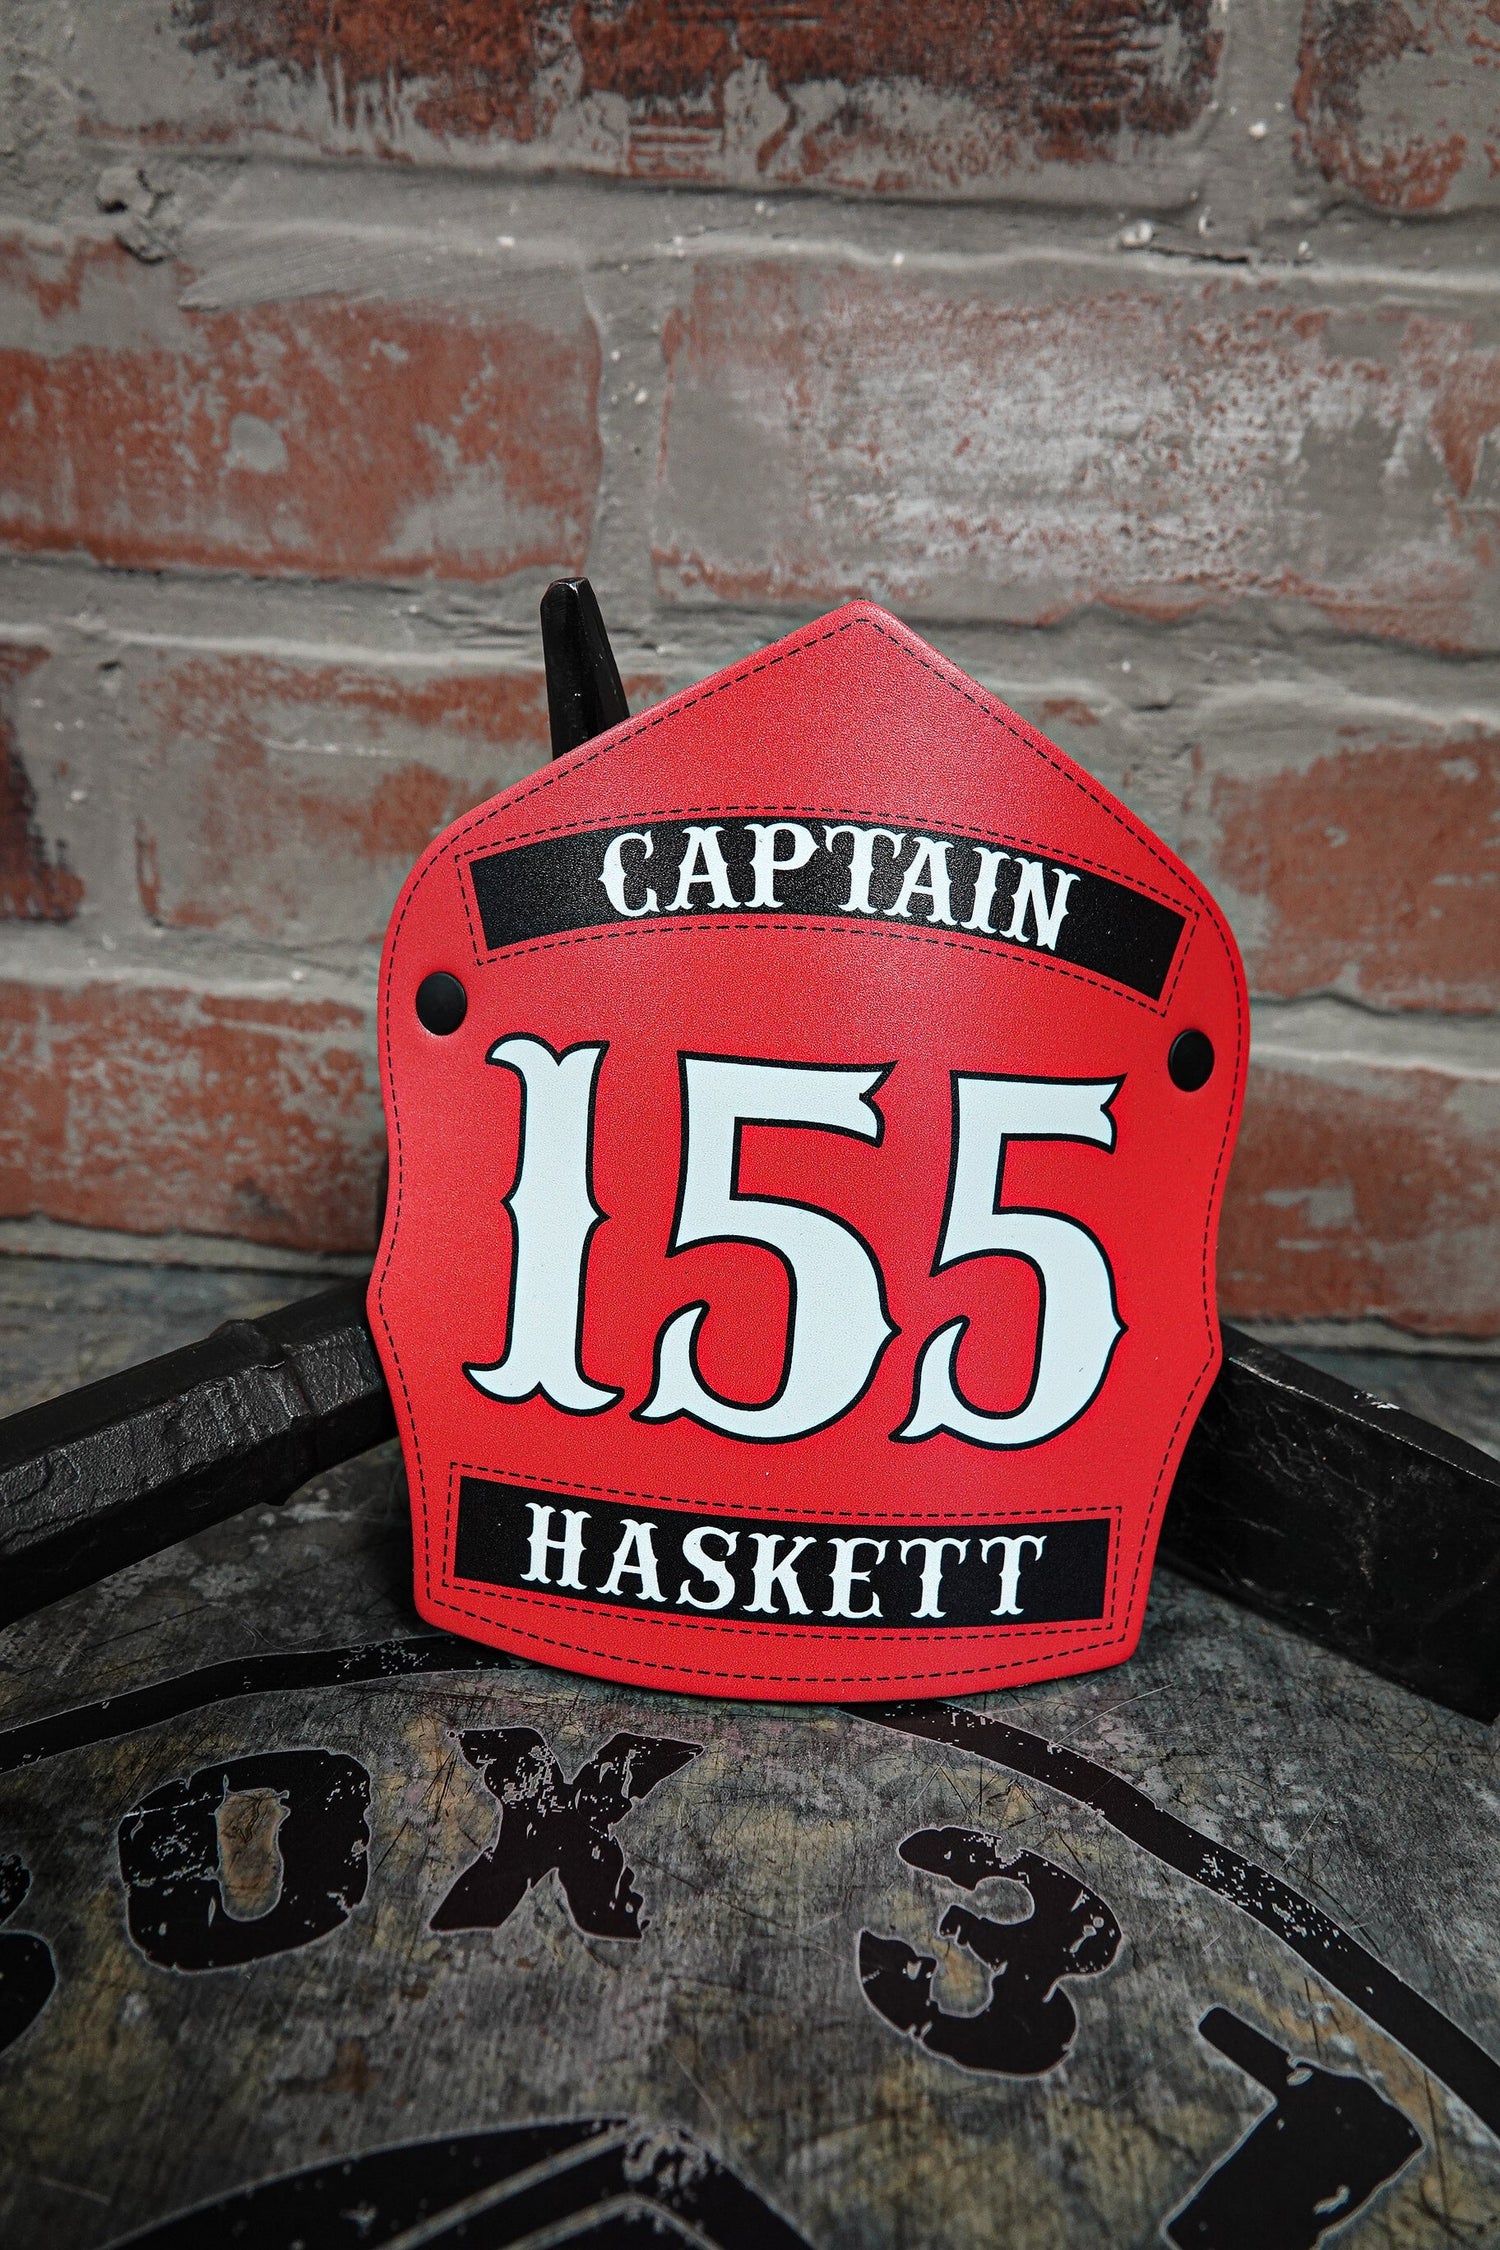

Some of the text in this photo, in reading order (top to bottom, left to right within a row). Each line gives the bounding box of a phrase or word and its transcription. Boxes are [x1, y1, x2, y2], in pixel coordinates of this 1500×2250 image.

[599, 821, 1081, 953] CAPTAIN
[462, 1032, 1128, 1450] 155
[519, 1502, 1048, 1621] HASKETT
[0, 1727, 704, 2054] OX
